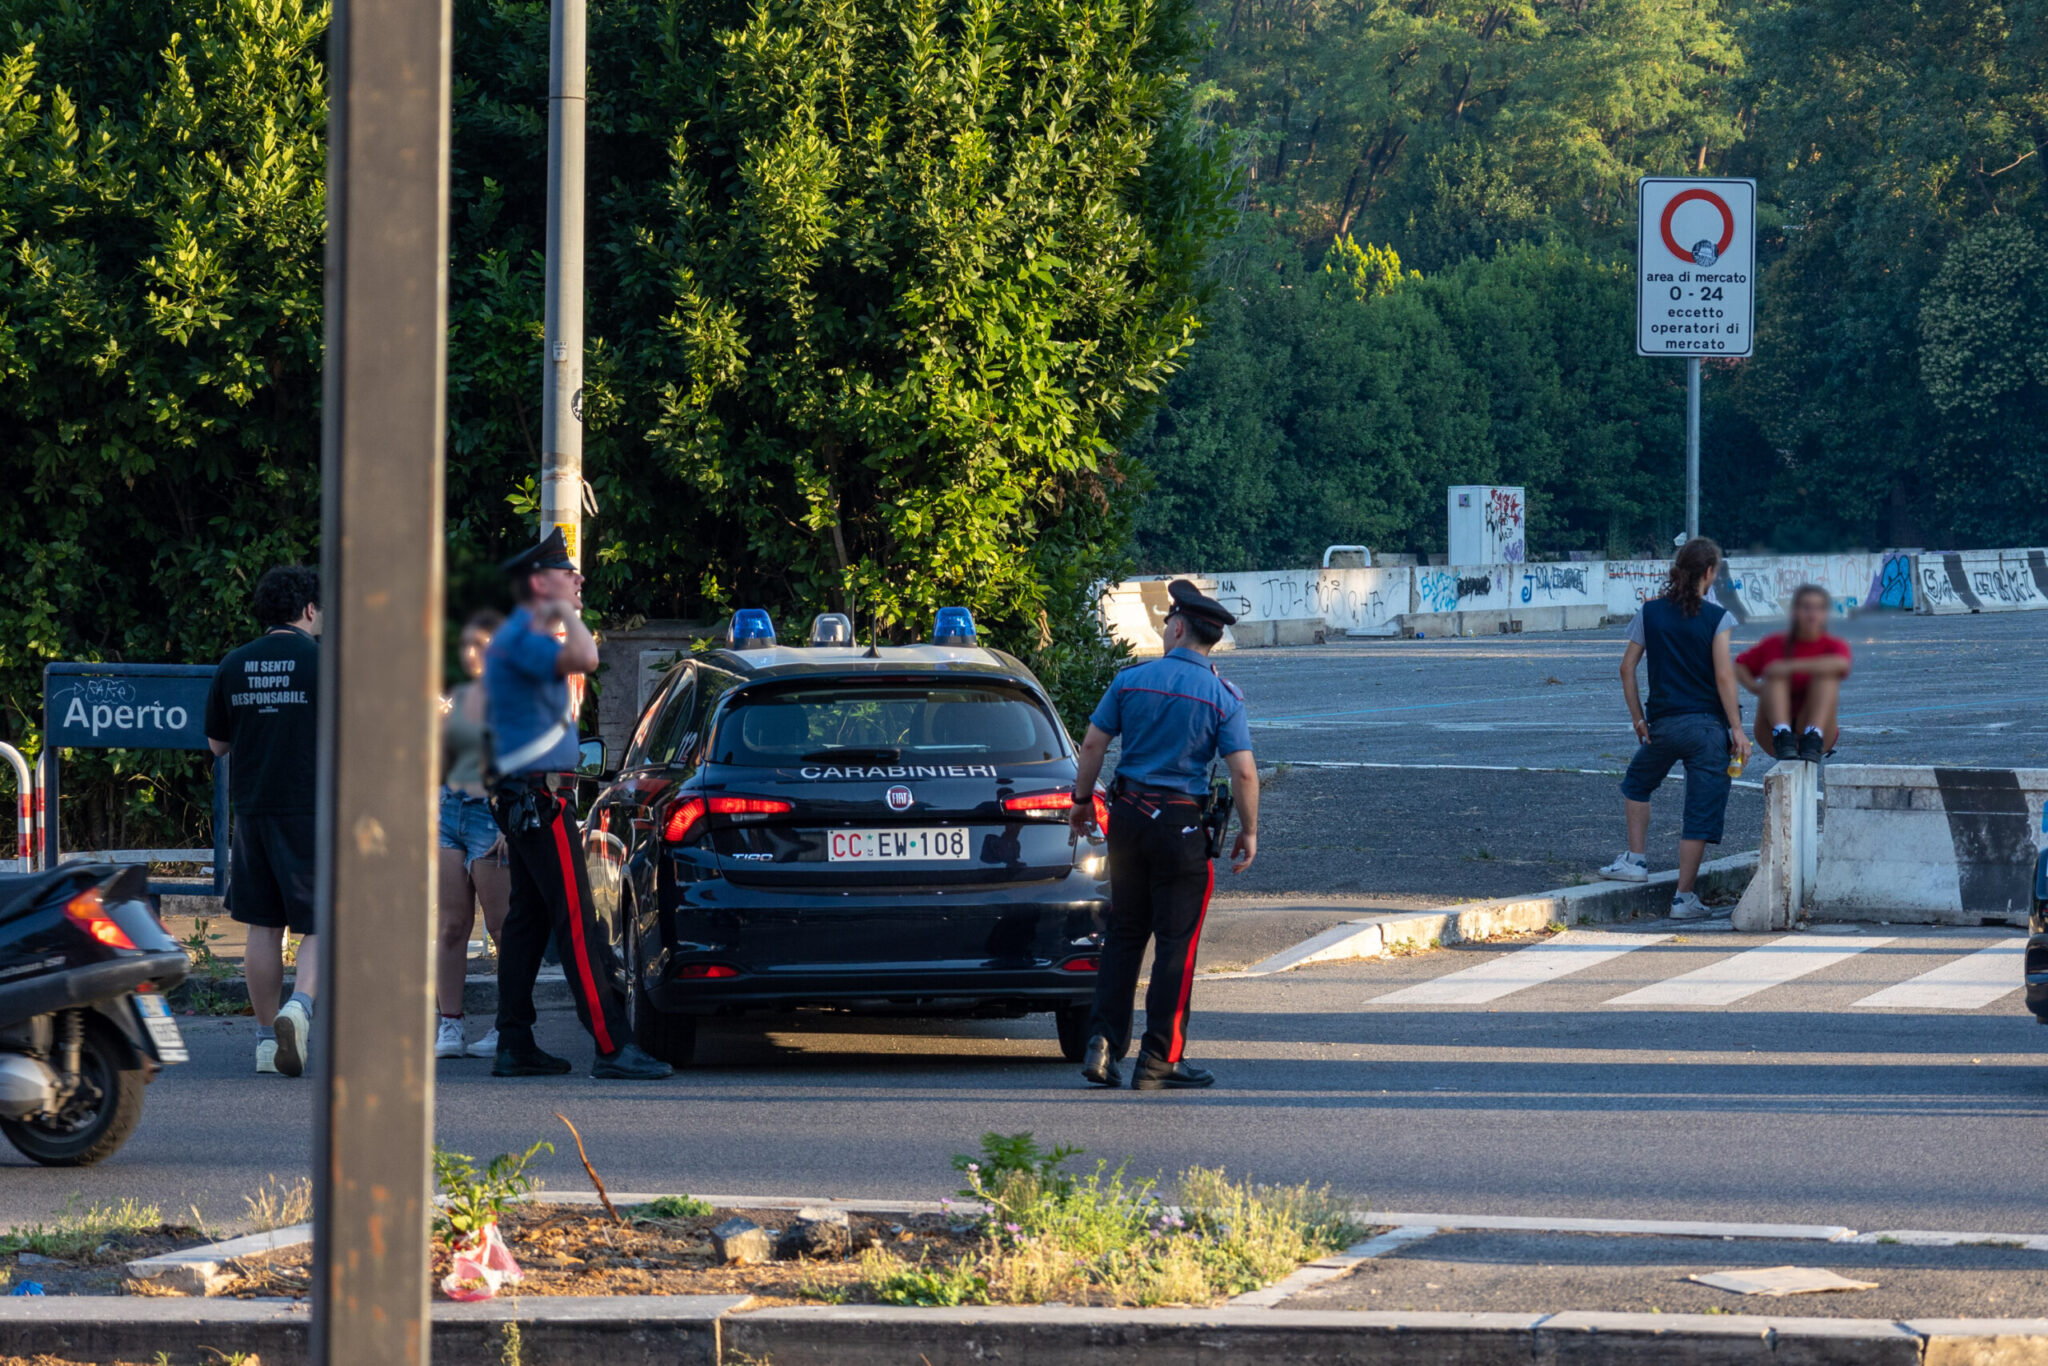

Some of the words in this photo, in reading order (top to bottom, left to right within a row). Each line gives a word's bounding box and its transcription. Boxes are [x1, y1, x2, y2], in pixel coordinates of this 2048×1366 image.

[1646, 273, 1674, 282] area
[1678, 271, 1691, 282] di
[1695, 272, 1747, 284] mercato
[1669, 286, 1682, 301] 0
[1700, 286, 1724, 301] 24
[1667, 307, 1724, 319] eccetto
[1651, 323, 1720, 336] operatori
[1726, 323, 1740, 334] di
[1665, 338, 1726, 350] mercato
[244, 660, 259, 672] MI
[260, 660, 295, 673] SENTO
[247, 675, 290, 689] TROPPO
[231, 690, 308, 706] RESPONSABILE.
[63, 697, 188, 737] Aperto
[800, 764, 998, 780] CARABINIERI
[891, 792, 908, 805] FIAT
[832, 833, 863, 858] CC
[878, 832, 908, 857] EW
[920, 831, 964, 856] 108
